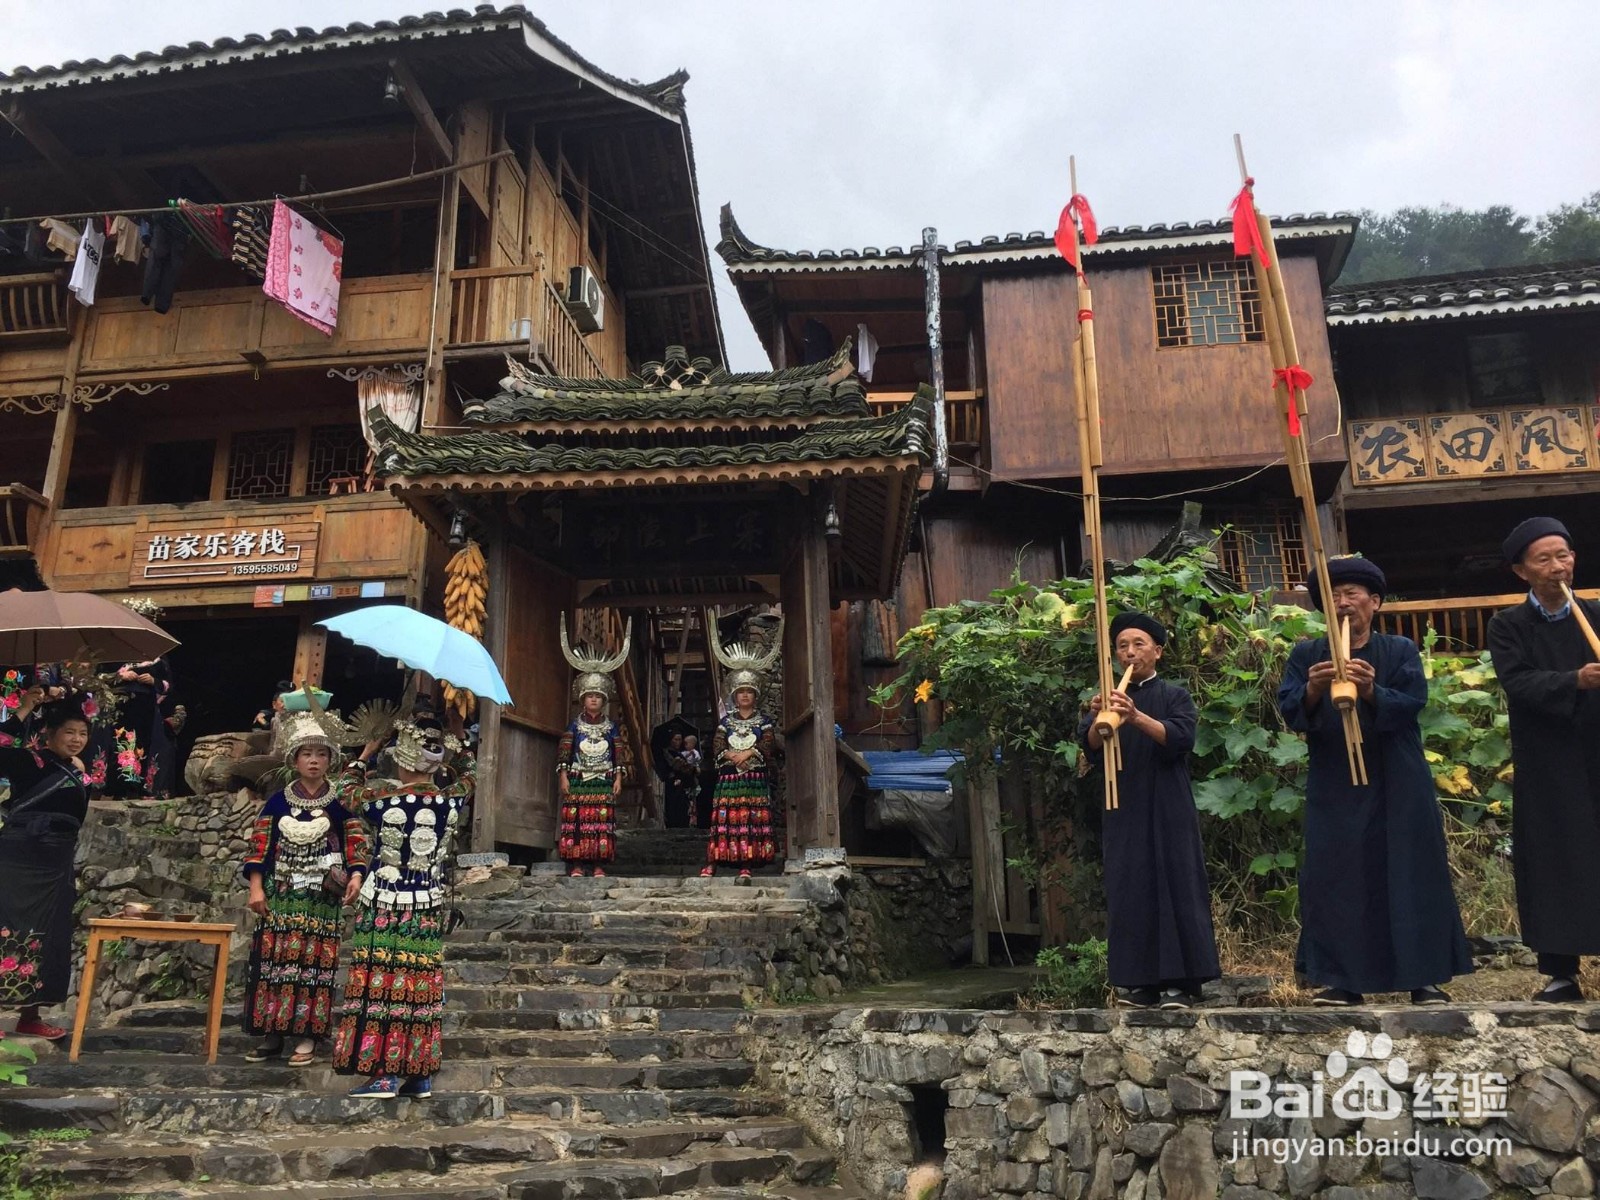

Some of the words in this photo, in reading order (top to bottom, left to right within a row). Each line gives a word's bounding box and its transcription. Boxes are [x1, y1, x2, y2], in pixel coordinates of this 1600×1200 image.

[148, 528, 285, 561] 苗家乐客栈
[232, 563, 298, 575] 13595585049
